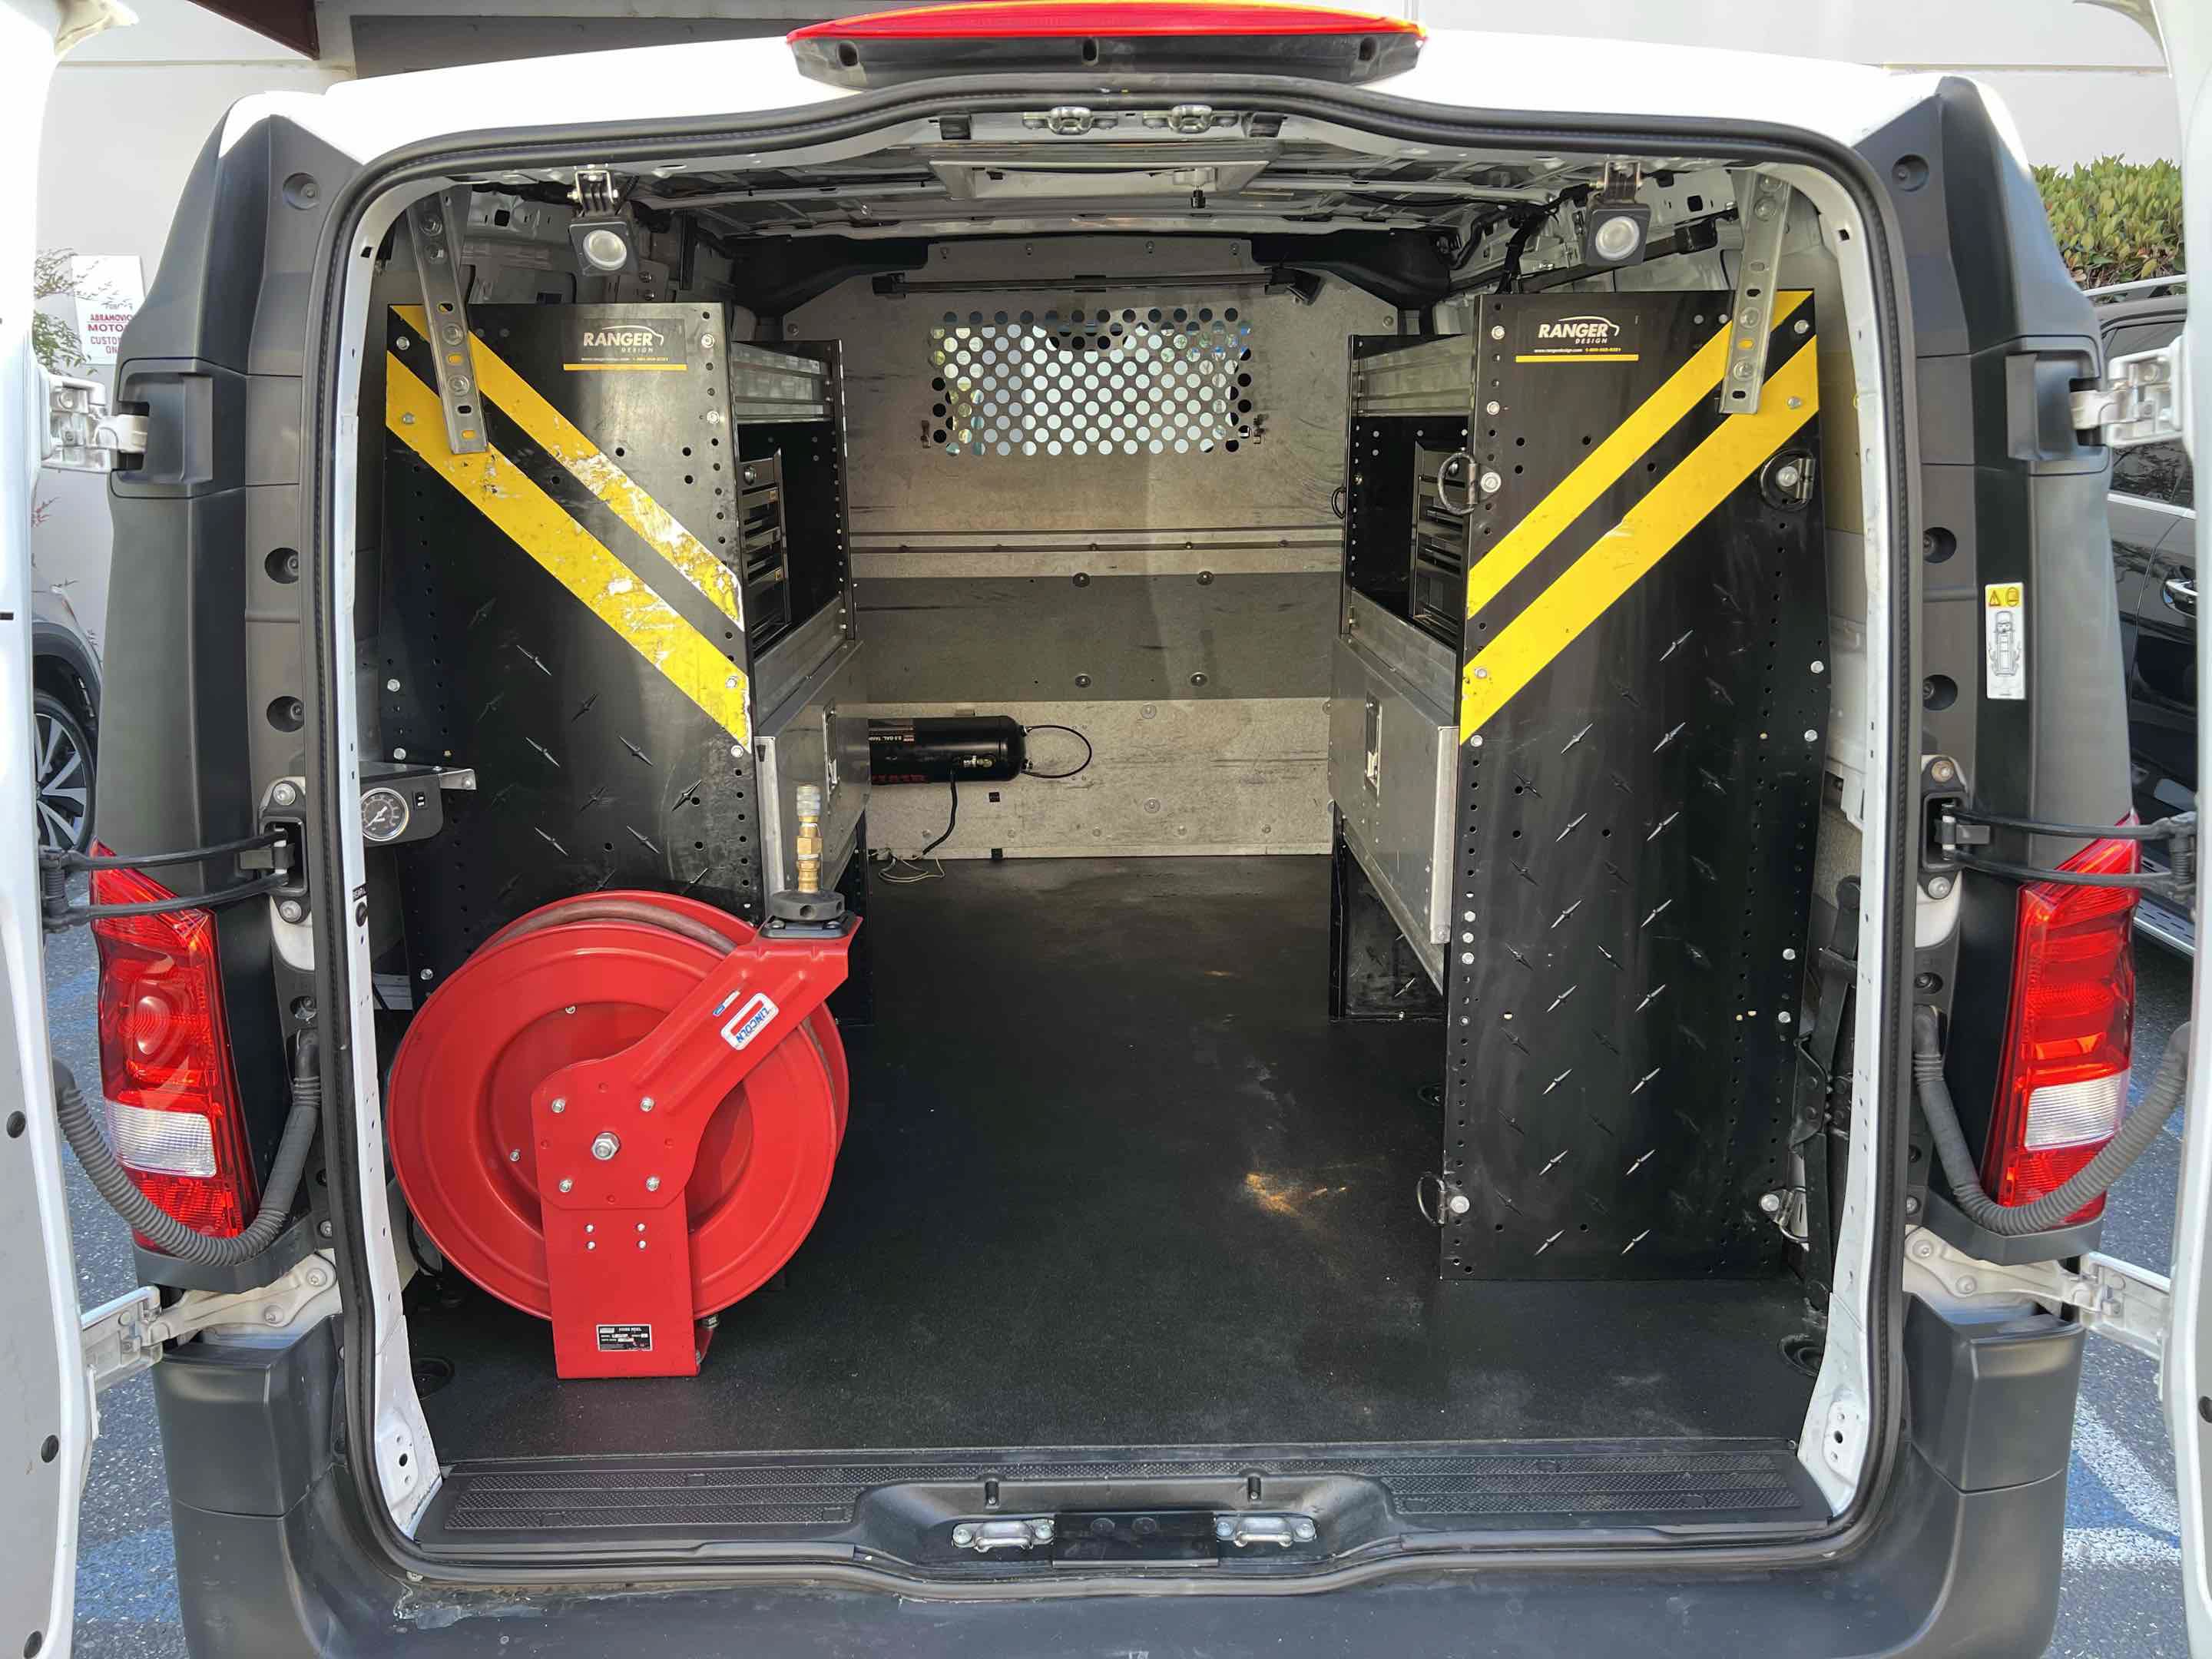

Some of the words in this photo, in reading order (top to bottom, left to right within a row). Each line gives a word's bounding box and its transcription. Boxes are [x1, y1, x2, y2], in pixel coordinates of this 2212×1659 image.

[583, 332, 654, 346] RANGER
[1538, 323, 1608, 339] RANGER
[735, 1006, 770, 1043] LINCOLN
